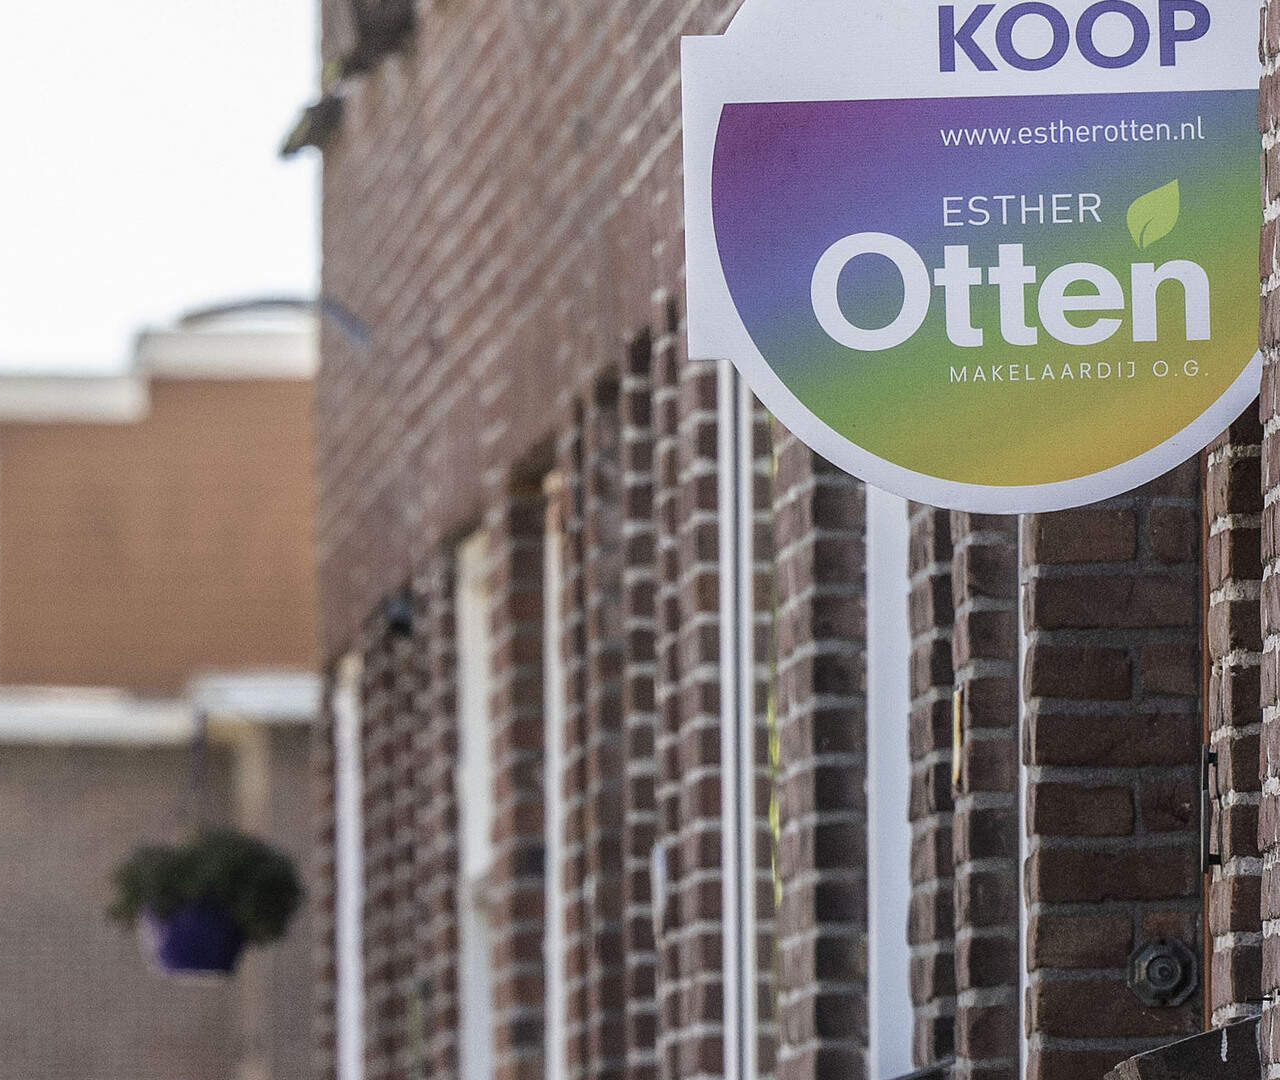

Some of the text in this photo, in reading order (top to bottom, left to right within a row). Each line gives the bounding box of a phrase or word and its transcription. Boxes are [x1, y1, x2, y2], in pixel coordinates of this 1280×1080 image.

[938, 0, 1211, 72] KOOP
[940, 116, 1205, 146] www.estherotten.nl
[942, 193, 1102, 226] ESTHER
[810, 232, 1211, 351] Otten
[948, 359, 1209, 384] MAKELAARDIJ O.G.
